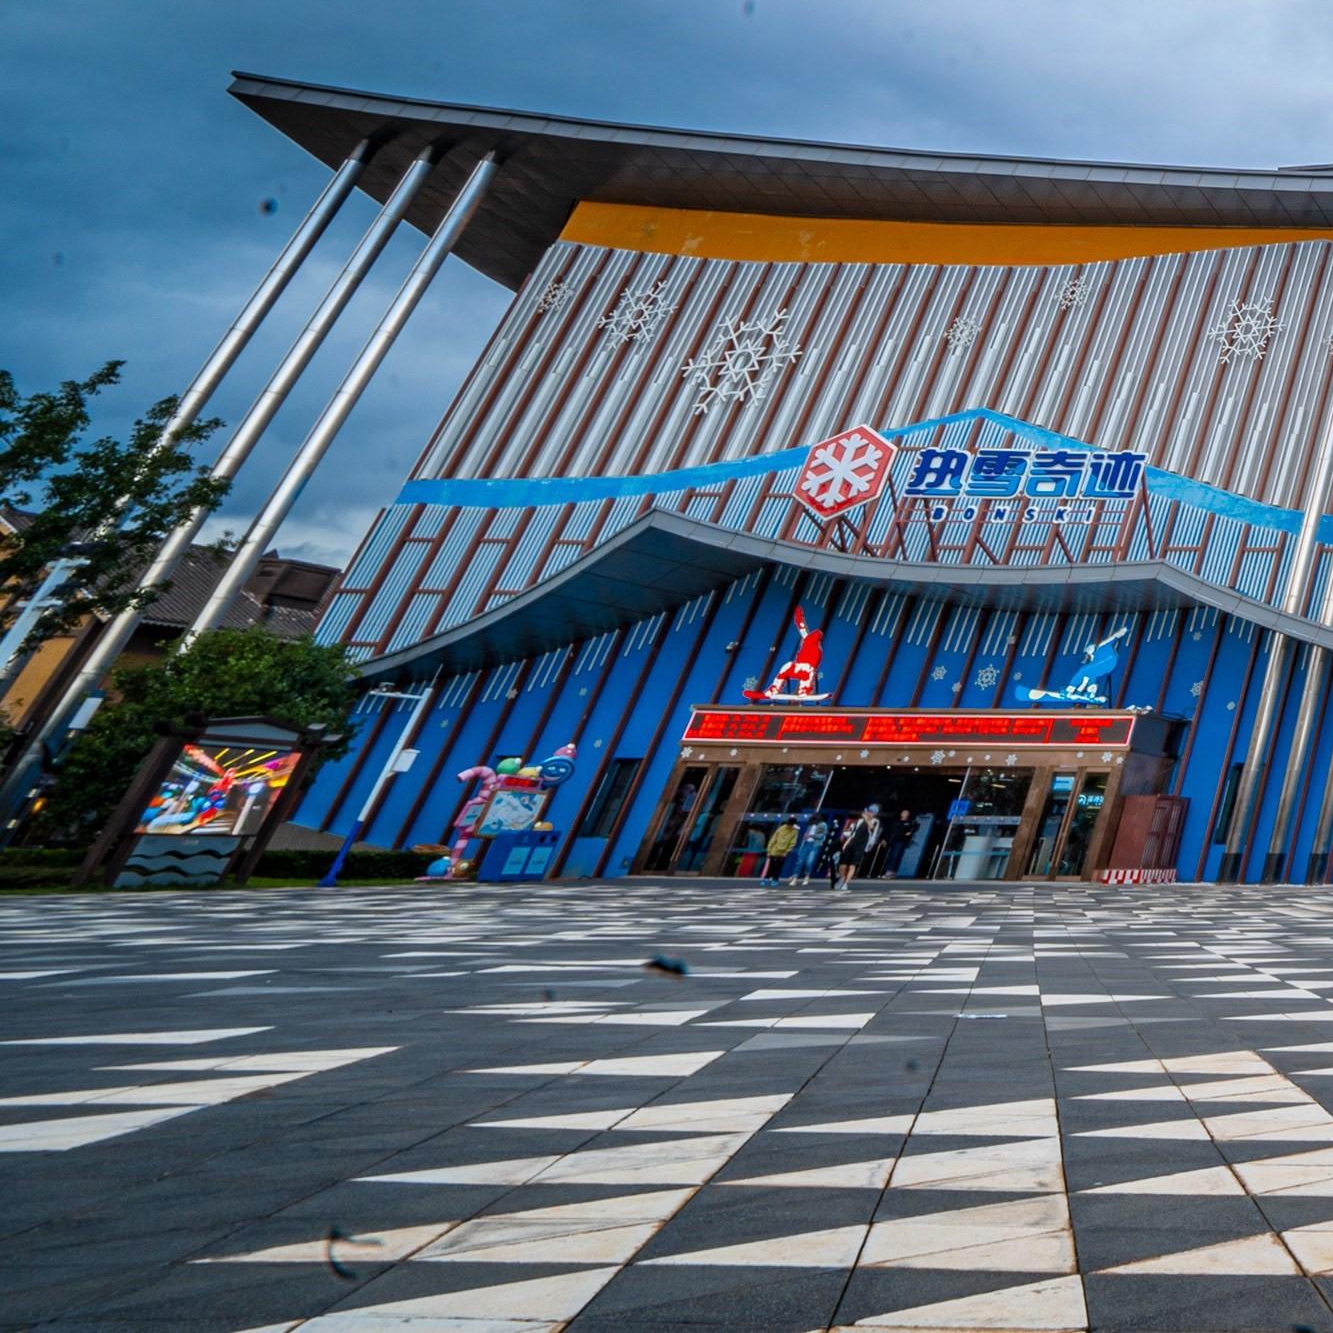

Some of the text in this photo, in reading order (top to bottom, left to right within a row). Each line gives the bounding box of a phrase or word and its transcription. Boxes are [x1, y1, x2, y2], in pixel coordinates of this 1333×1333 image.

[904, 449, 1146, 498] 热雪奇迹
[931, 507, 1095, 523] BONSKI
